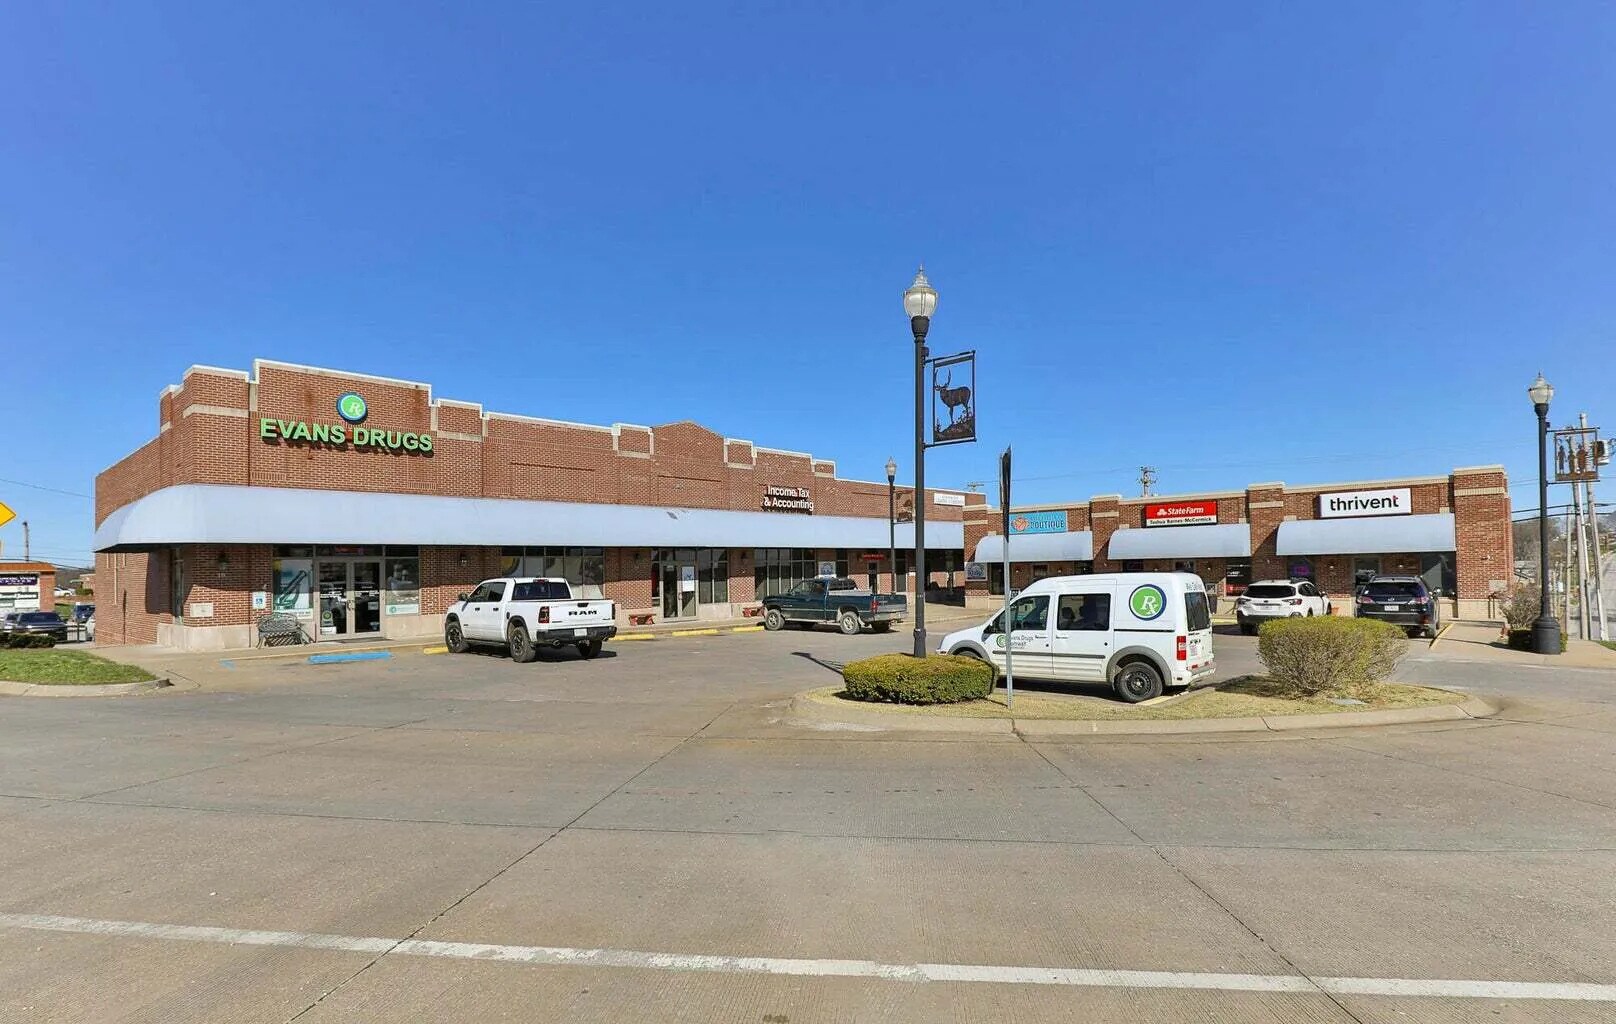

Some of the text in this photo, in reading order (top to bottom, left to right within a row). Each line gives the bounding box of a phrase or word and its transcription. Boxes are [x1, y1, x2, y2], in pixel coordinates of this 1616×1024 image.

[260, 418, 433, 452] EVANS DRUGS
[767, 485, 810, 498] Income Tax
[763, 496, 814, 511] & Accounting
[1330, 495, 1399, 511] thrivent
[1030, 520, 1065, 529] BOUTIQUE
